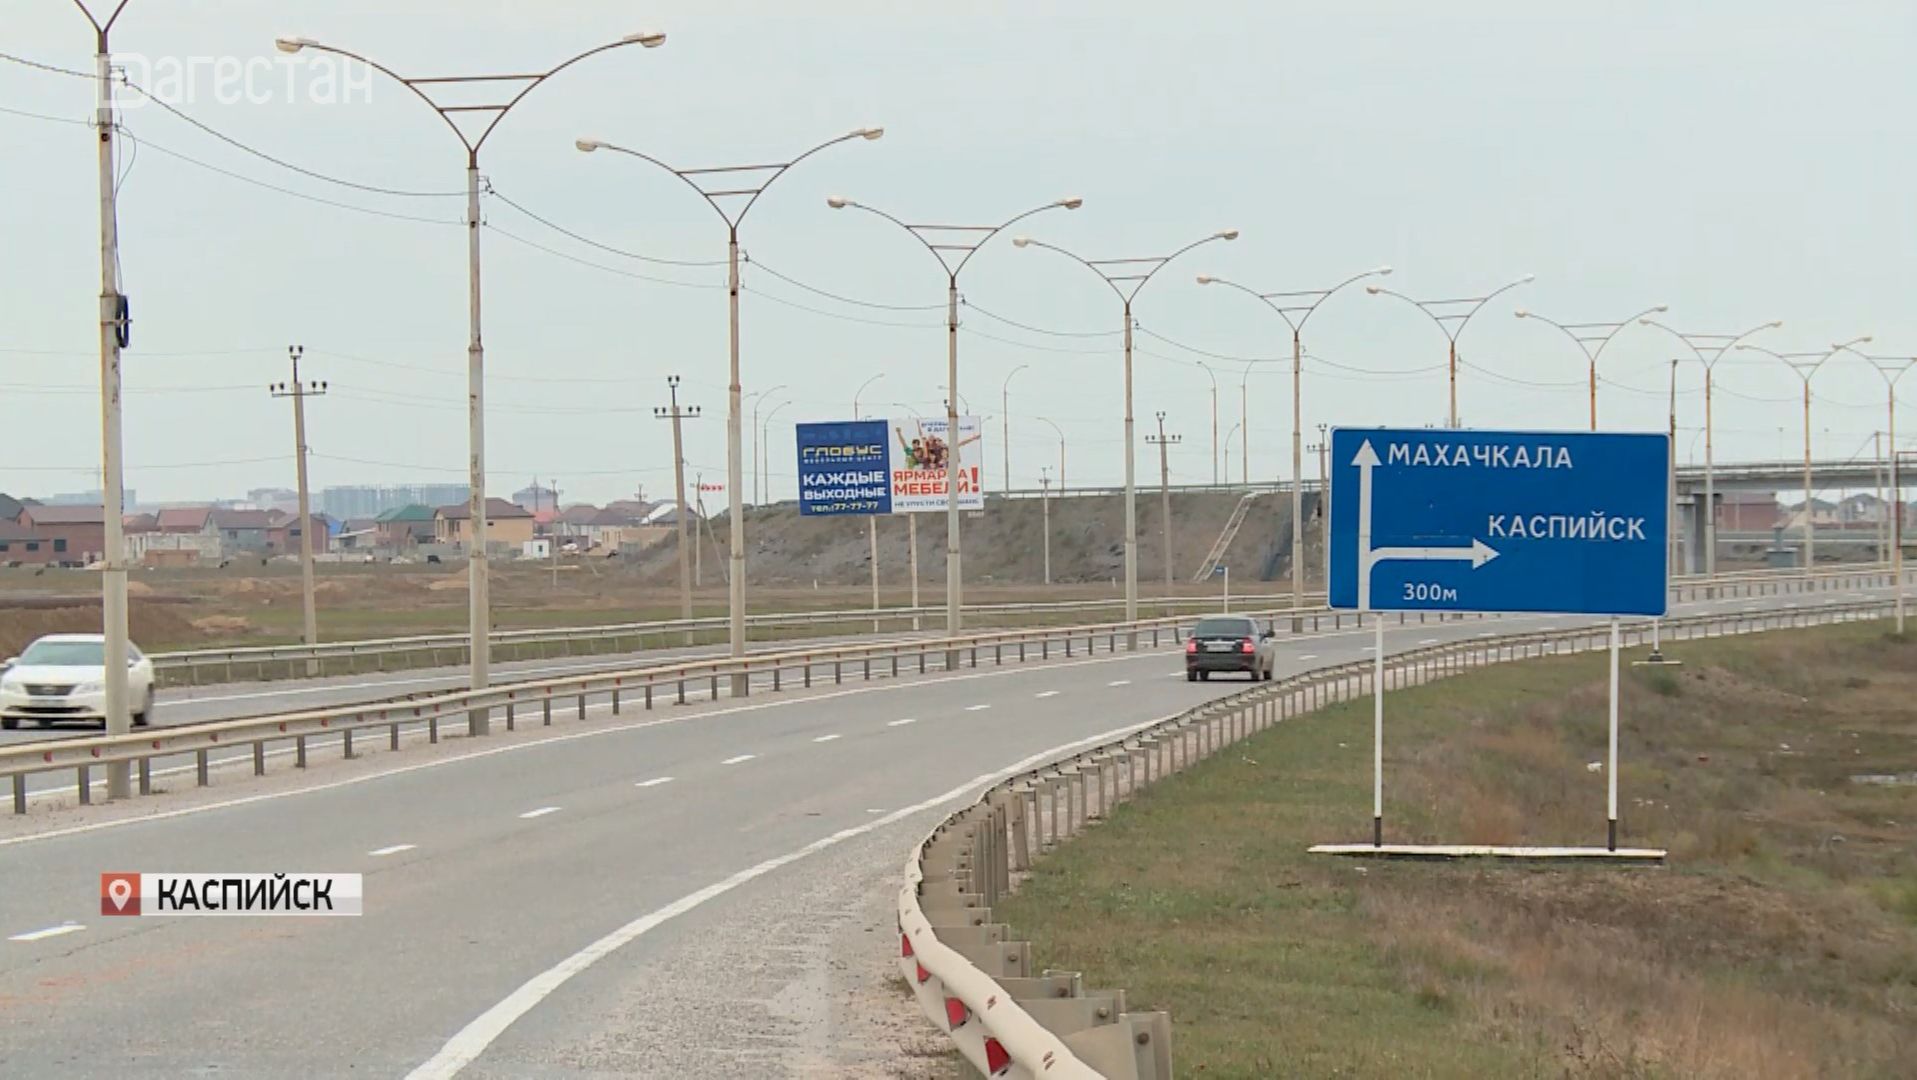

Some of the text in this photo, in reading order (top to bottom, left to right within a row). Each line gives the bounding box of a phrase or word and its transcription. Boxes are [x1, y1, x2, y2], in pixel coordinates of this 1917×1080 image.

[1388, 443, 1573, 469] МАХАЧКАЛА
[803, 471, 885, 486] КАЖДЫЕ
[894, 469, 967, 481] ЯРМАРА
[804, 487, 886, 500] ВЫХОДНЫЕ
[1488, 510, 1646, 540] КАСПИЙСК
[1403, 583, 1457, 601] 300м
